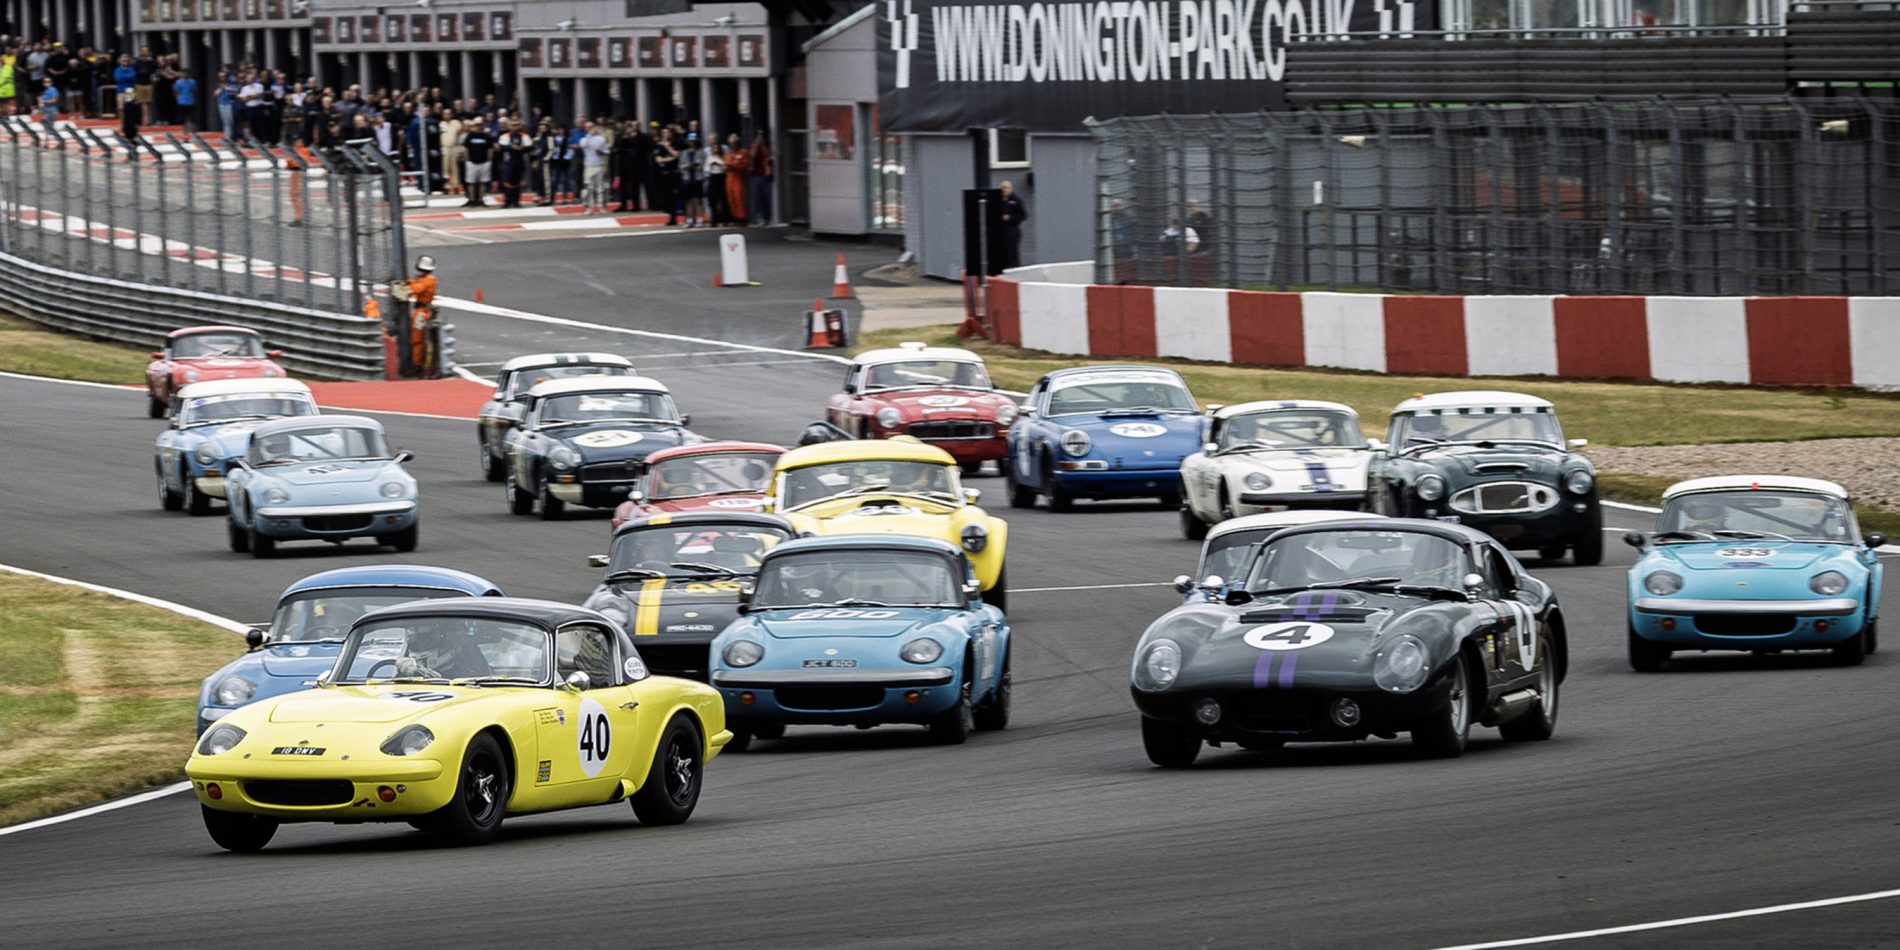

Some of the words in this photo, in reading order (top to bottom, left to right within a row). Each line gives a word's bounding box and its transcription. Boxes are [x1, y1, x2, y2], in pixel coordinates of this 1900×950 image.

[931, 0, 1355, 82] WWW.DONINGTON-PARK.COUK
[1722, 549, 1770, 557] 333
[787, 609, 901, 620] 600
[1260, 625, 1312, 644] 4
[391, 692, 454, 703] 40
[580, 713, 611, 762] 40
